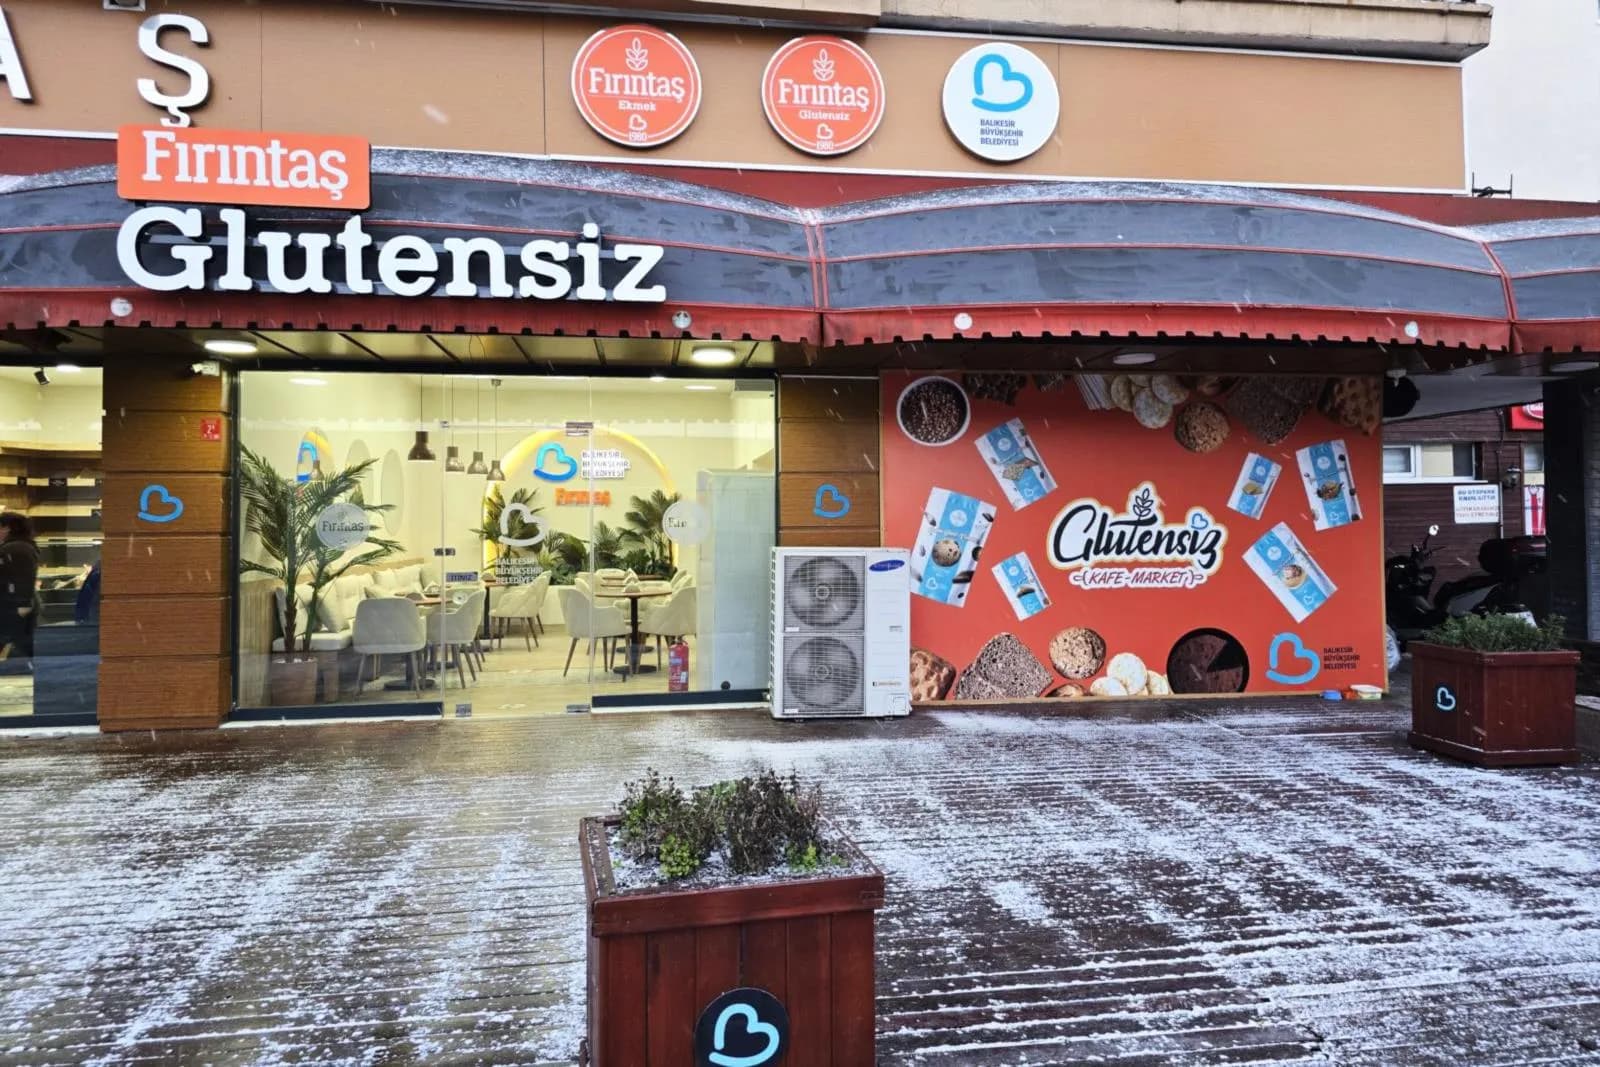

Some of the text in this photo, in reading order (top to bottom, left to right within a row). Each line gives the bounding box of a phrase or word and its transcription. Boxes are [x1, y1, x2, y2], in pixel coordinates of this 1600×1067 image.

[588, 67, 685, 103] Fırıntaş
[778, 79, 869, 112] Fırıntaş
[618, 100, 656, 111] Ekmek
[799, 109, 850, 121] Glutensiz
[142, 130, 348, 200] Fırıntaş
[116, 206, 666, 302] Glutensiz
[1053, 504, 1222, 570] Glutensiz
